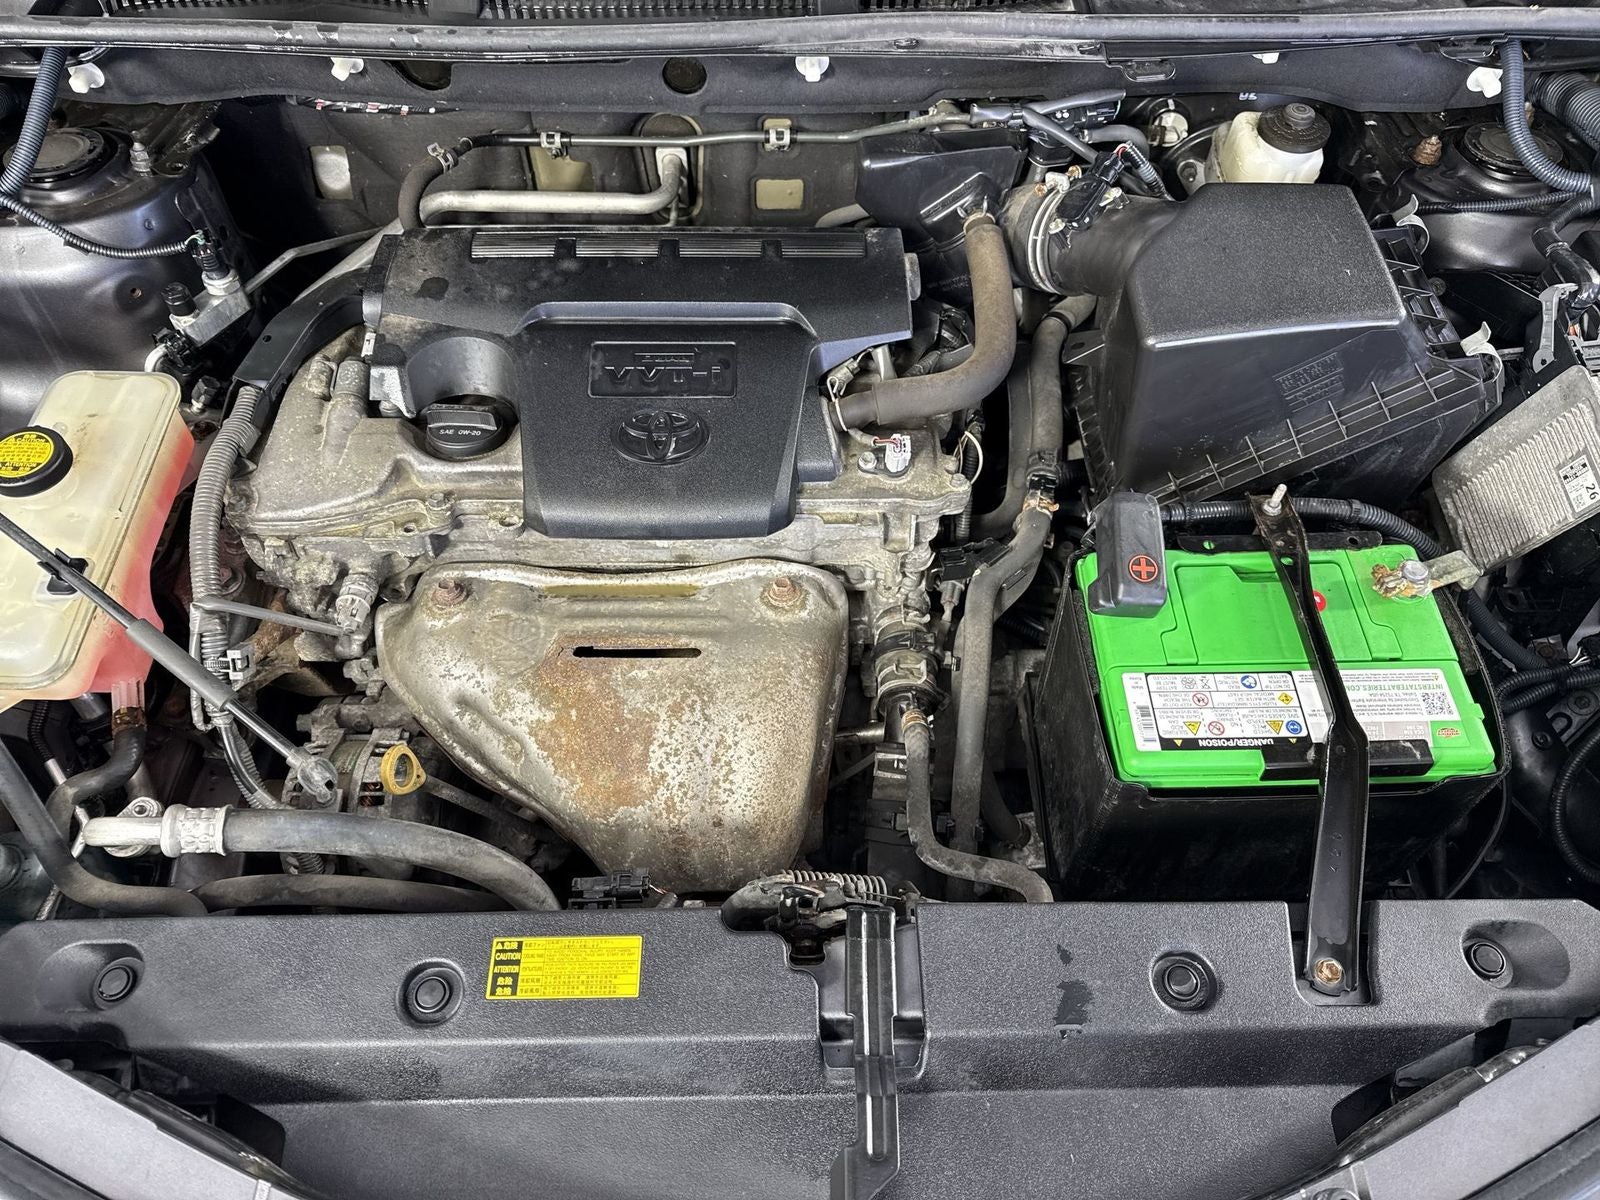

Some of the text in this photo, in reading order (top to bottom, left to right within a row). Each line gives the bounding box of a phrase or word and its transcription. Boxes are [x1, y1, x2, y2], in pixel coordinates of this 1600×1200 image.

[1585, 483, 1600, 501] 26
[495, 952, 522, 961] CAUTION
[493, 965, 520, 973] ATTENTION
